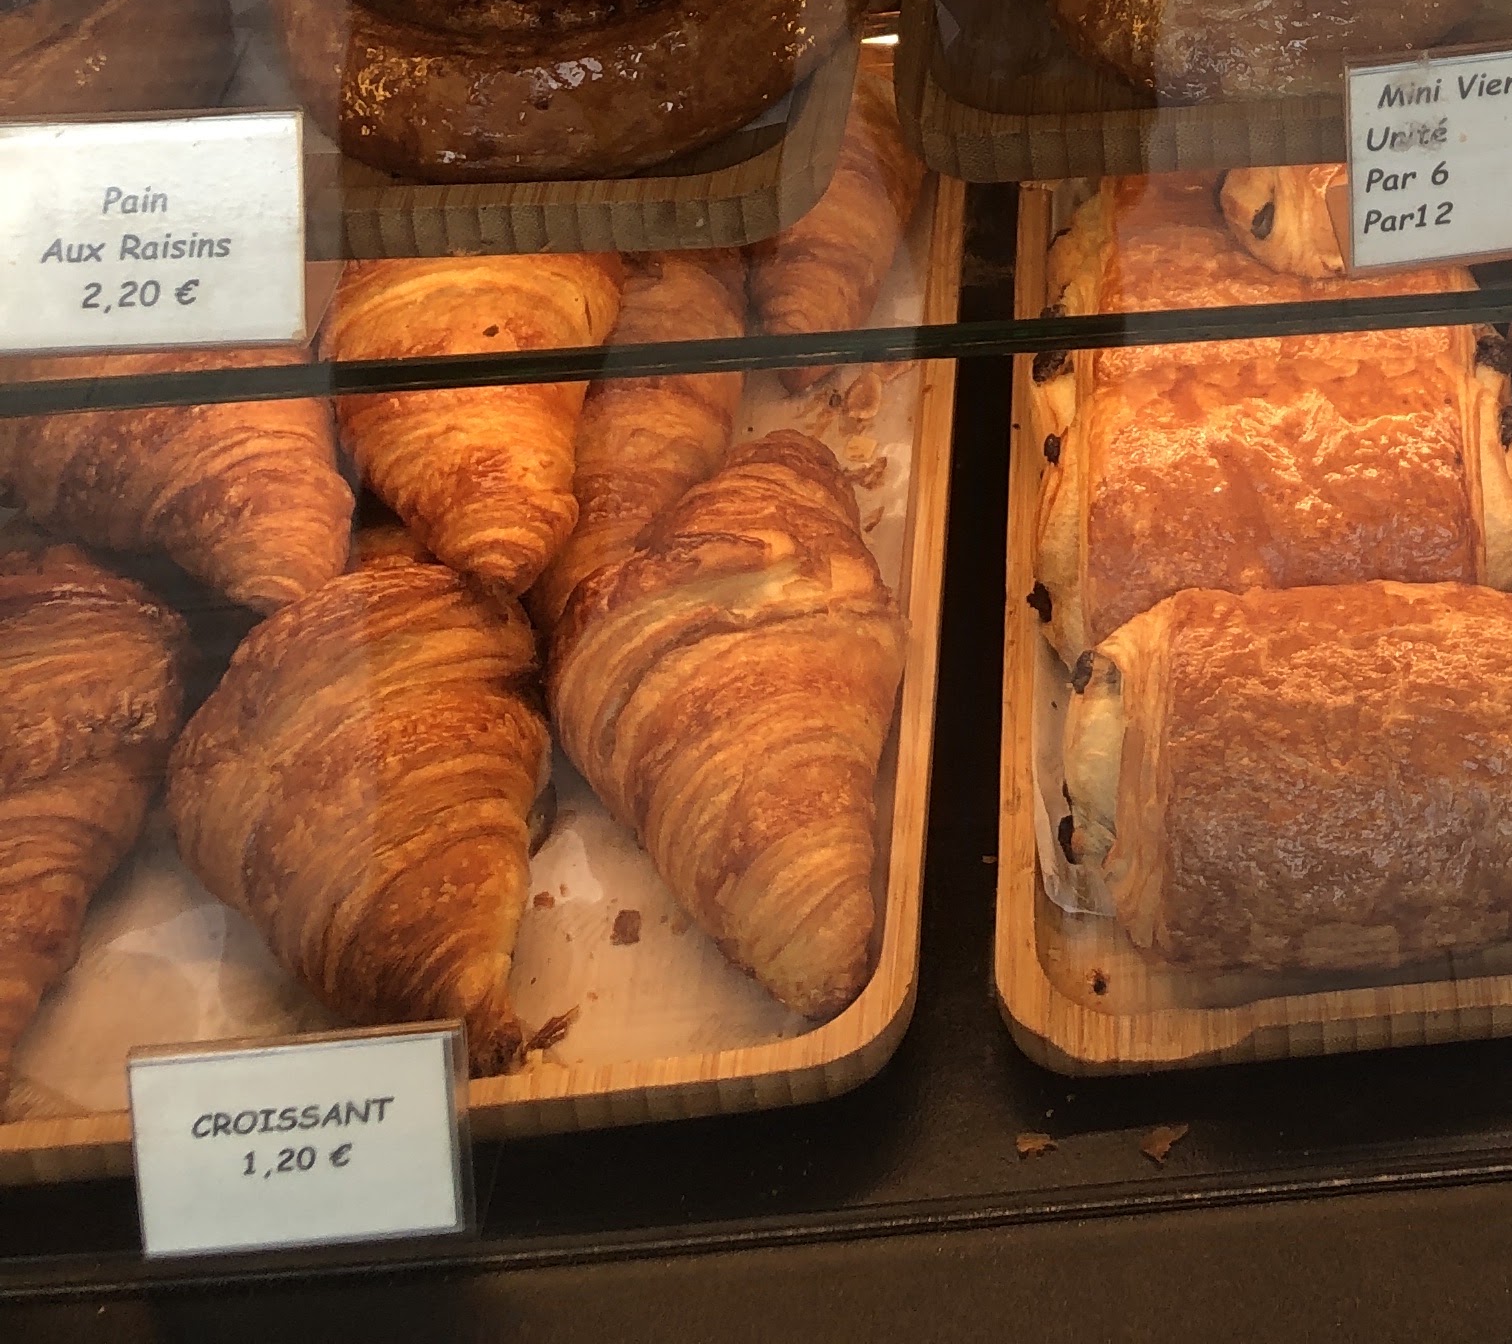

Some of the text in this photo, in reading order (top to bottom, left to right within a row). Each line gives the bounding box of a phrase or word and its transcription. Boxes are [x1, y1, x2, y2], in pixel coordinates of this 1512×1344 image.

[1377, 79, 1442, 109] Mini
[1365, 167, 1417, 193] Par
[1431, 161, 1449, 185] 6
[102, 186, 168, 214] Pain
[40, 232, 232, 263] Aux Raisins
[82, 279, 200, 313] 2,20 €
[191, 1097, 395, 1139] CROISSANT
[243, 1144, 353, 1179] 1,20 €
